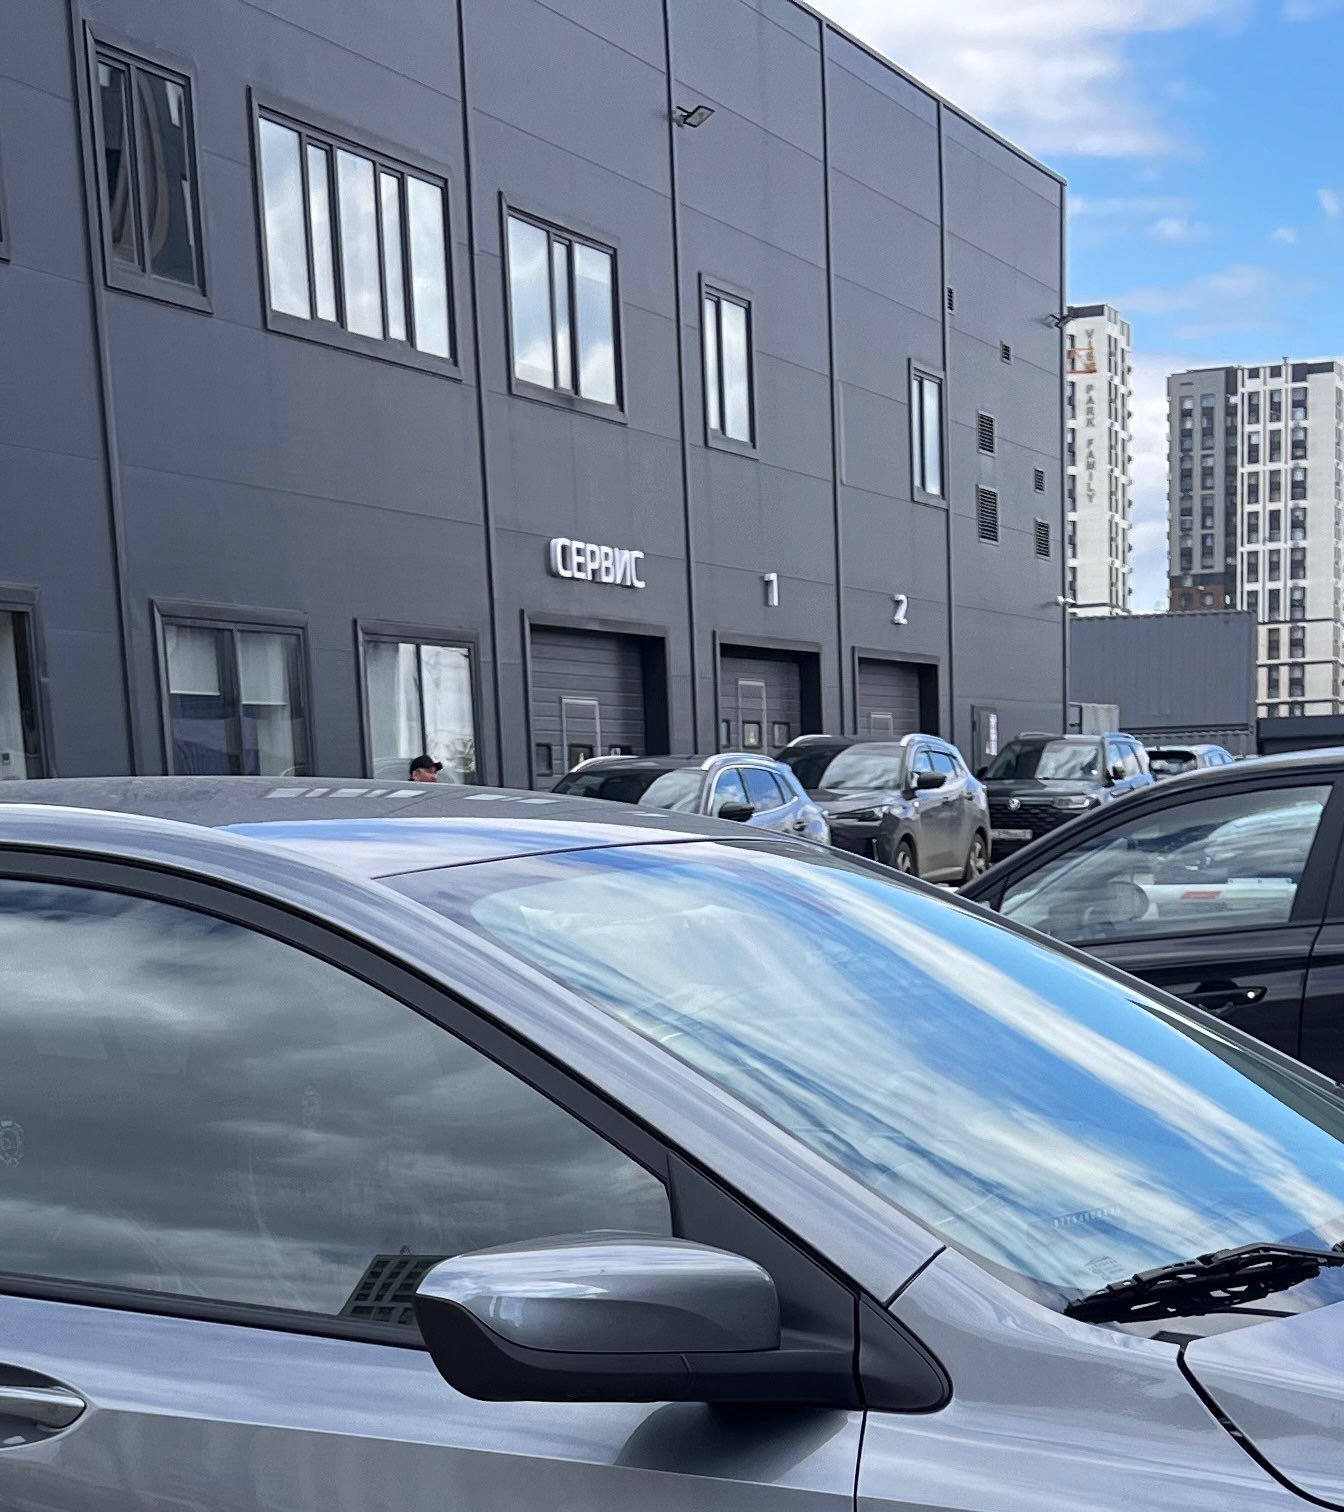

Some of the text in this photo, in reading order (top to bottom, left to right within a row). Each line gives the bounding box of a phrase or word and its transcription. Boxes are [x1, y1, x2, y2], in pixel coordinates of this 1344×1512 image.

[1086, 384, 1095, 427] PARK
[1086, 438, 1095, 503] FAMILY
[550, 538, 646, 588] СЕРВИС
[764, 572, 779, 606] 1
[894, 594, 908, 624] 2
